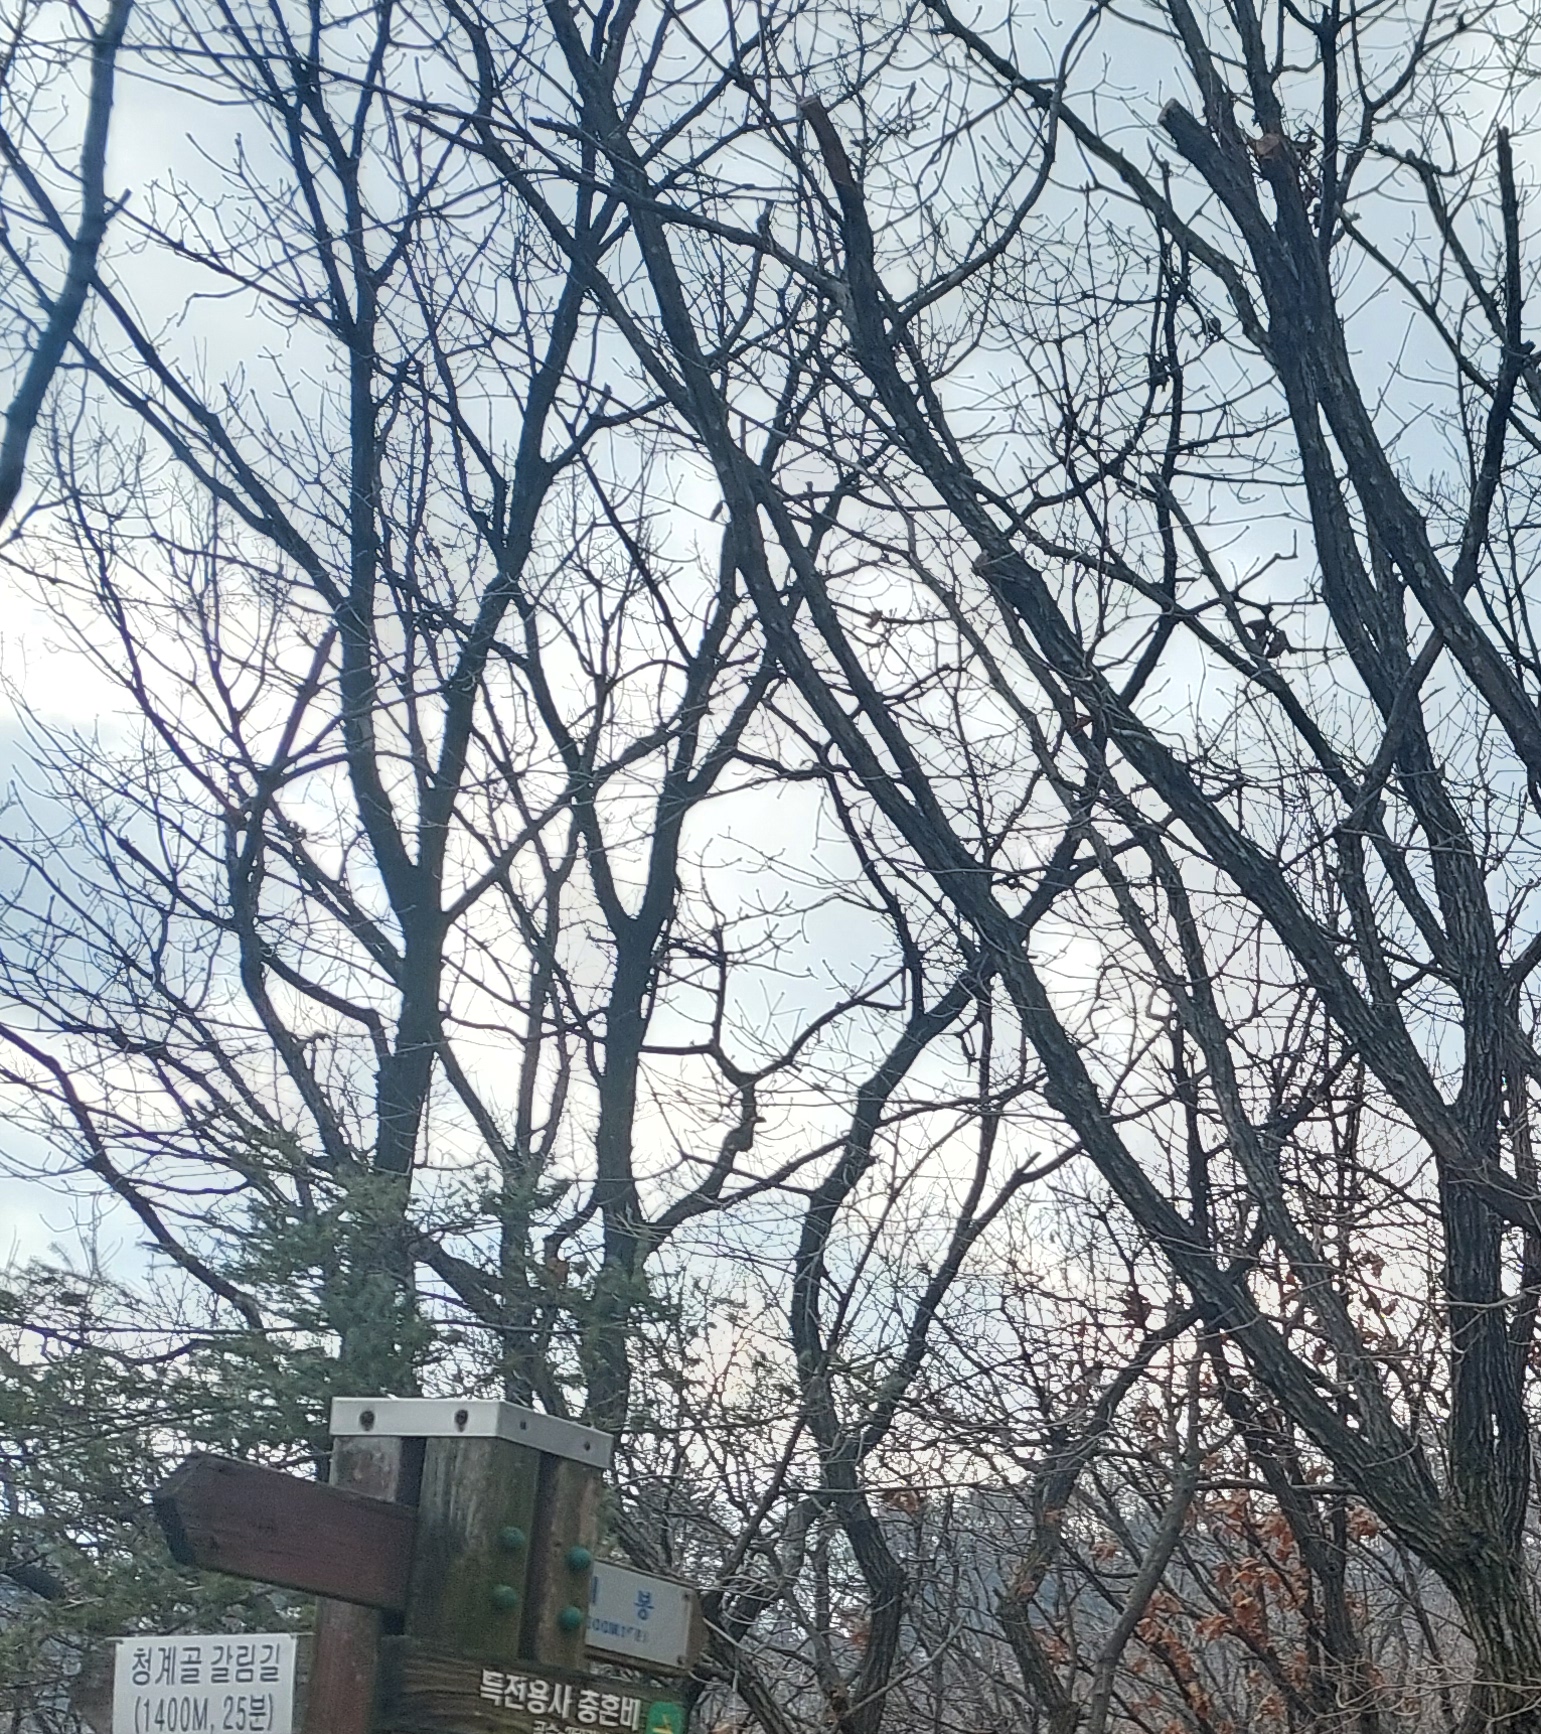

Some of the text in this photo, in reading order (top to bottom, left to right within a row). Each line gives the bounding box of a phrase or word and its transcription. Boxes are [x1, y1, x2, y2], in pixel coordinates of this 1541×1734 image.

[132, 1643, 280, 1686] 청계골 갈림길
[134, 1693, 273, 1734] (1400M, 25분)
[480, 1668, 641, 1731] 특전용사 충혼비
